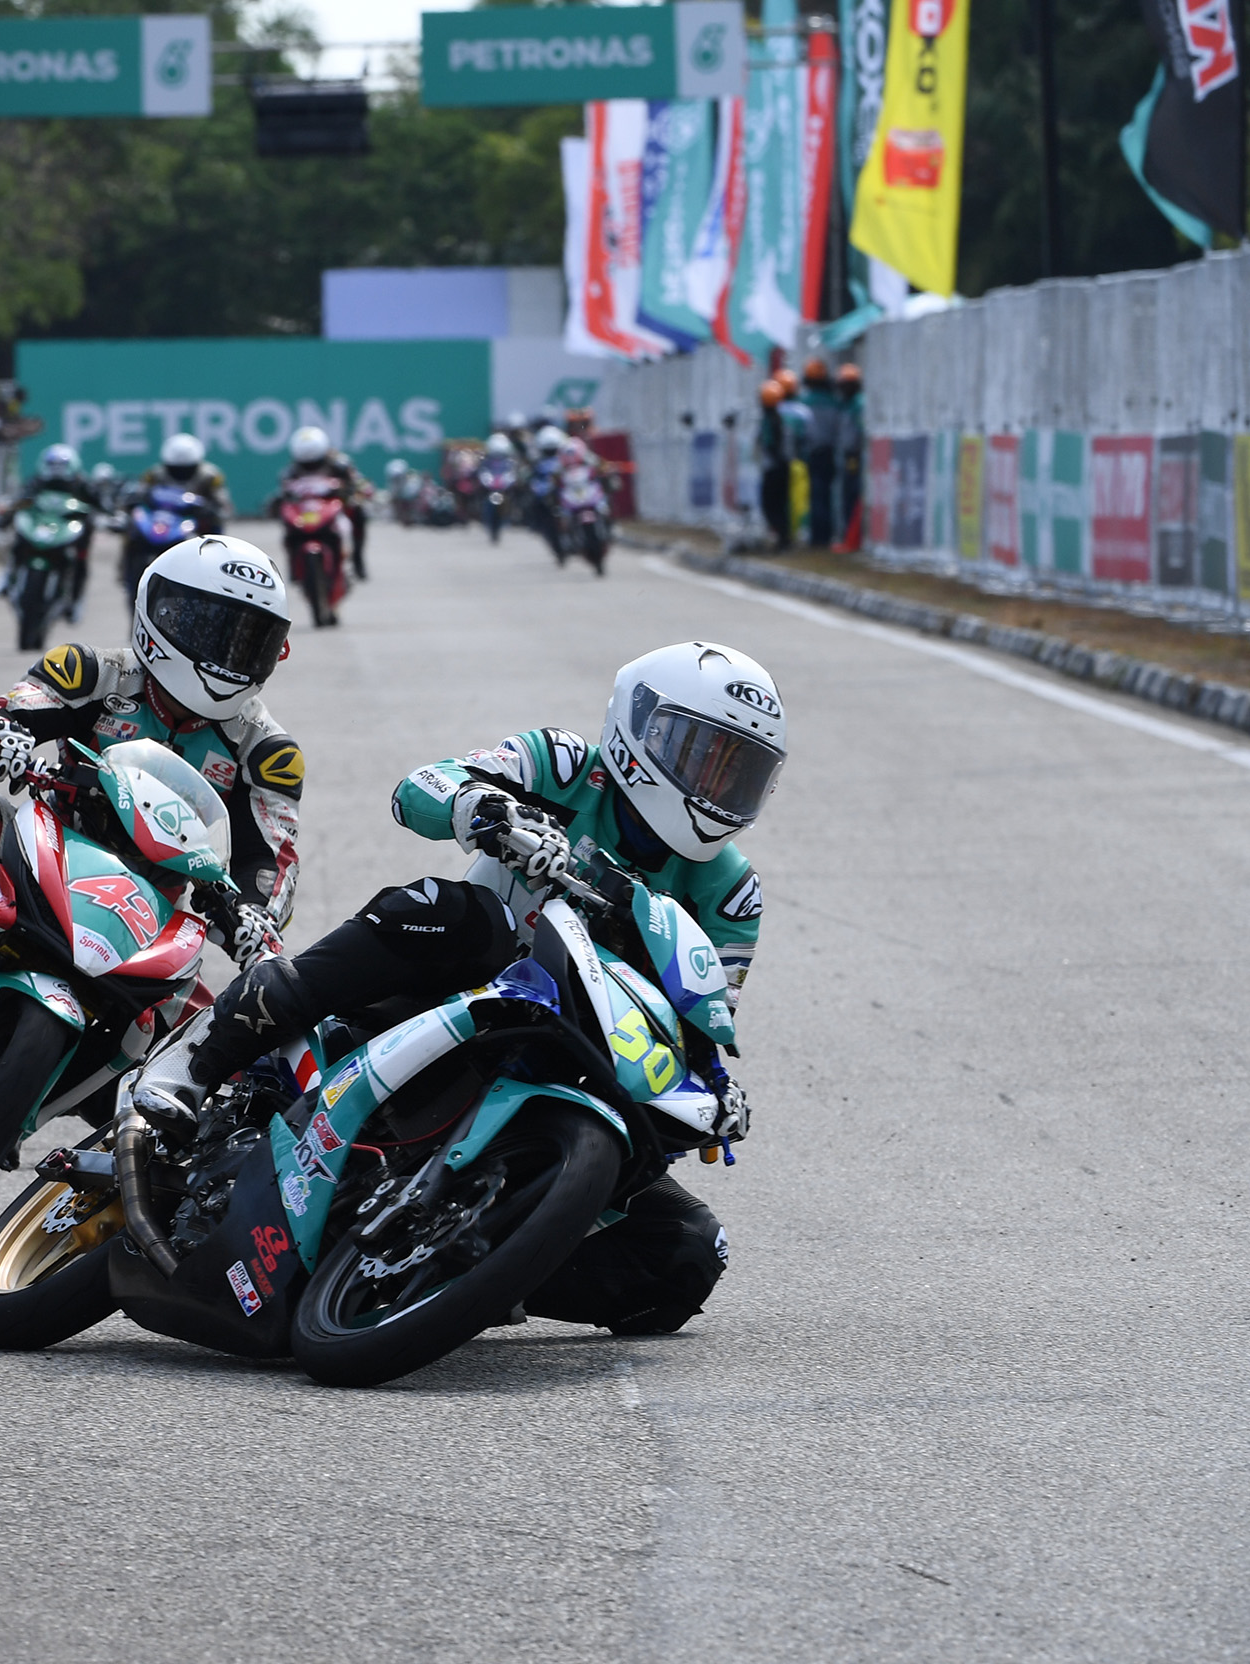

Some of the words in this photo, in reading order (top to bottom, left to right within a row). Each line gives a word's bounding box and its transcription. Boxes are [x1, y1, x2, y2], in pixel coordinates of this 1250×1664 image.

[448, 35, 653, 71] PETRONAS
[64, 397, 444, 455] PETRONAS
[228, 562, 271, 585] KYT
[218, 668, 250, 683] RCB
[730, 683, 780, 712] KYT
[608, 725, 660, 788] KYT
[203, 768, 234, 788] RCB
[710, 804, 743, 823] RCB
[67, 874, 161, 949] 42
[401, 924, 446, 933] TAICHI
[79, 935, 111, 963] Sprinta
[564, 919, 602, 986] PETRONAS
[608, 1007, 676, 1095] 50
[294, 1137, 338, 1184] KYT
[251, 1225, 278, 1273] RCB
[229, 1269, 247, 1300] racing
[234, 1262, 249, 1286] uma
